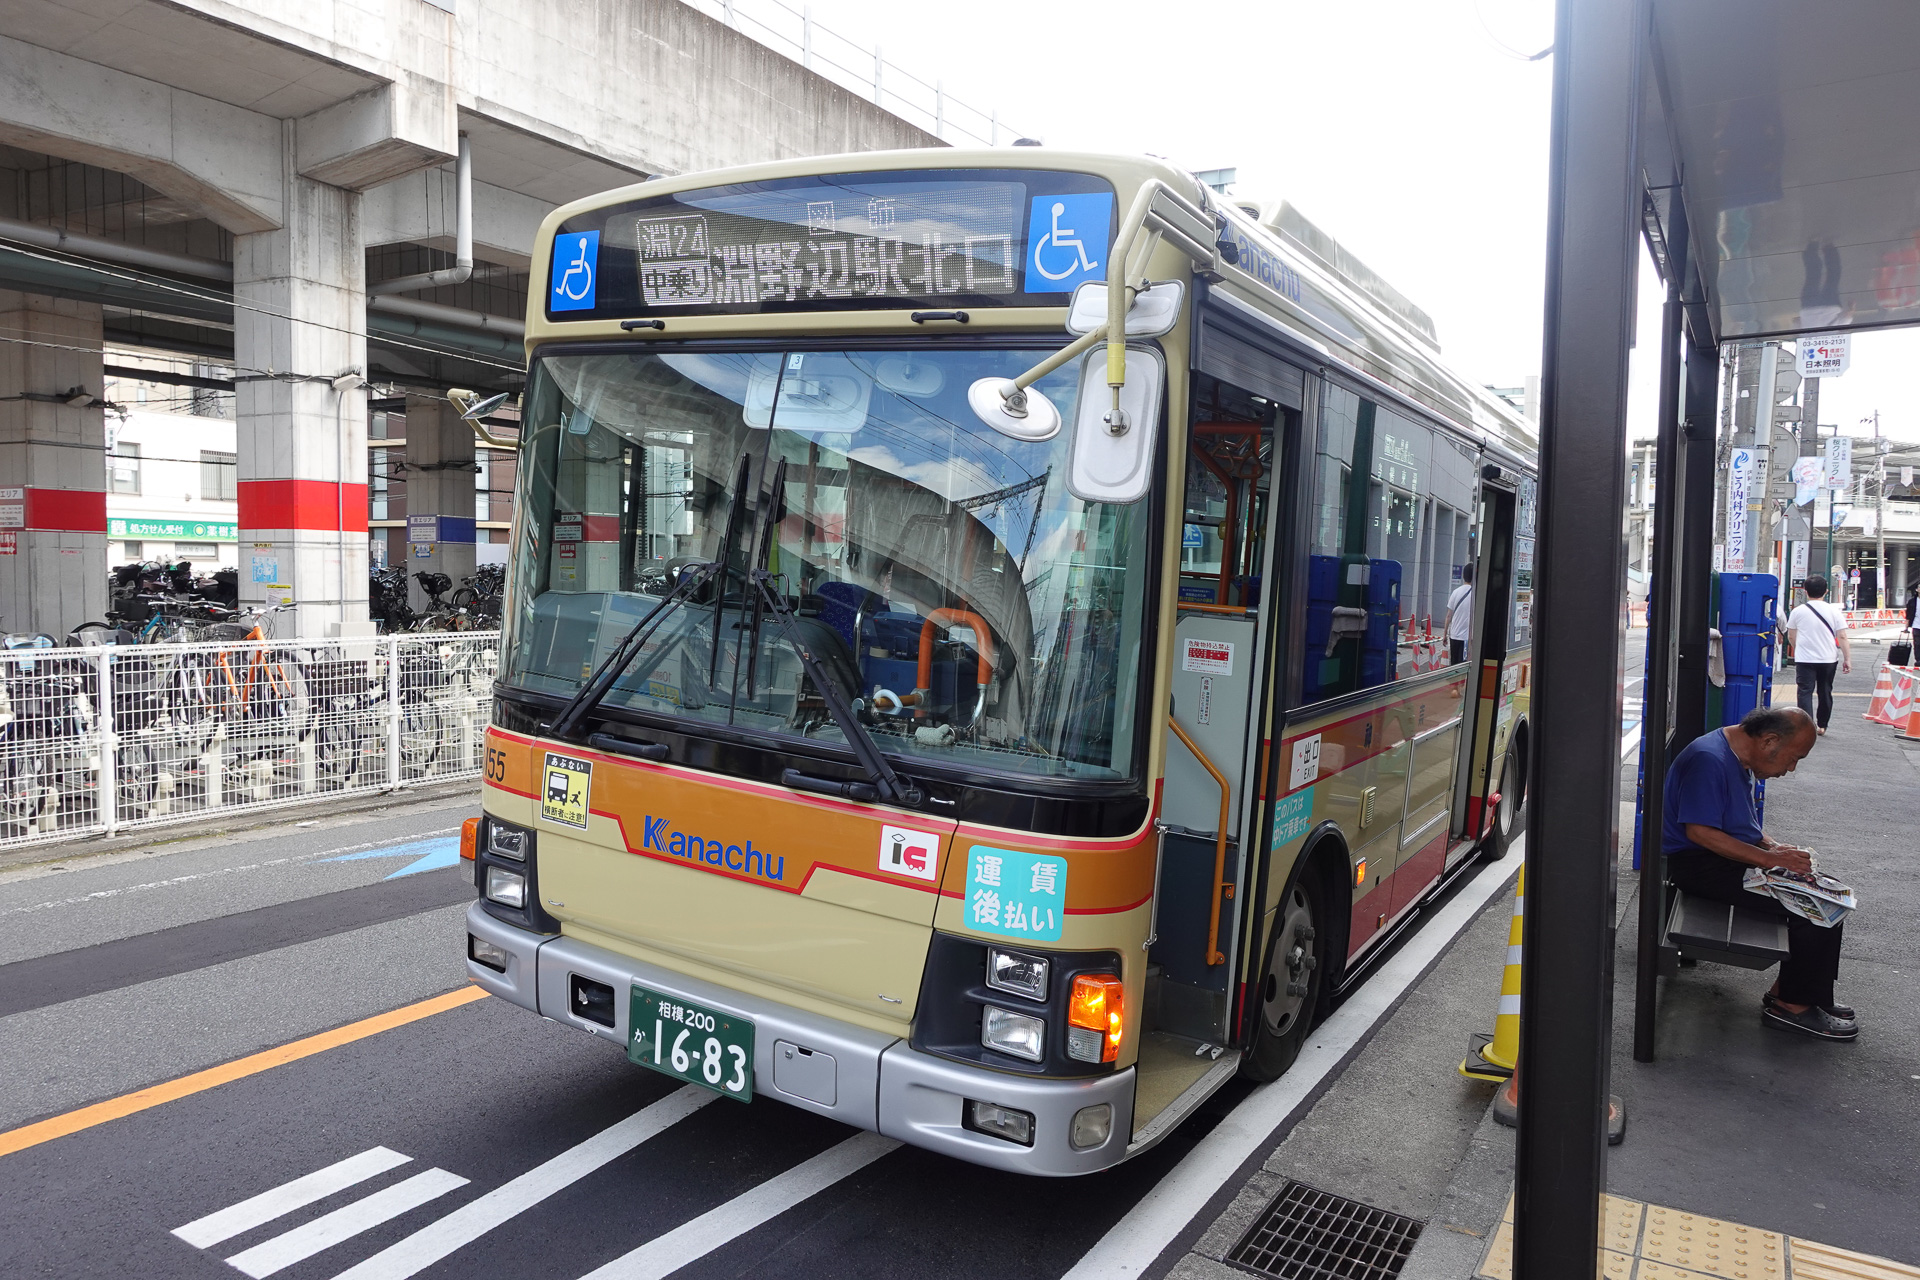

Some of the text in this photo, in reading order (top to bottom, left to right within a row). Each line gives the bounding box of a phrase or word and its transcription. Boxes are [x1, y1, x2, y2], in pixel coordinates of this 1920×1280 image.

[643, 224, 706, 259] 淵24
[711, 231, 1013, 305] 淵野辺駅北口
[645, 267, 710, 300] 中乗り
[1805, 359, 1841, 369] 日本照明
[1731, 470, 1744, 557] こう内科クリニック
[129, 523, 184, 535] 処方せん受付
[1188, 640, 1231, 650] 危険物持込禁止
[551, 757, 584, 772] あぶない
[1304, 740, 1319, 765] 出口
[1304, 765, 1316, 780] EXIT
[544, 805, 585, 824] 横断者に注意!
[1275, 795, 1305, 822] このバスは
[1272, 815, 1308, 847] 中ドア乗車です
[643, 814, 785, 881] Kanachu
[972, 889, 1055, 932] 後払い
[634, 1018, 747, 1093] か 16-83
